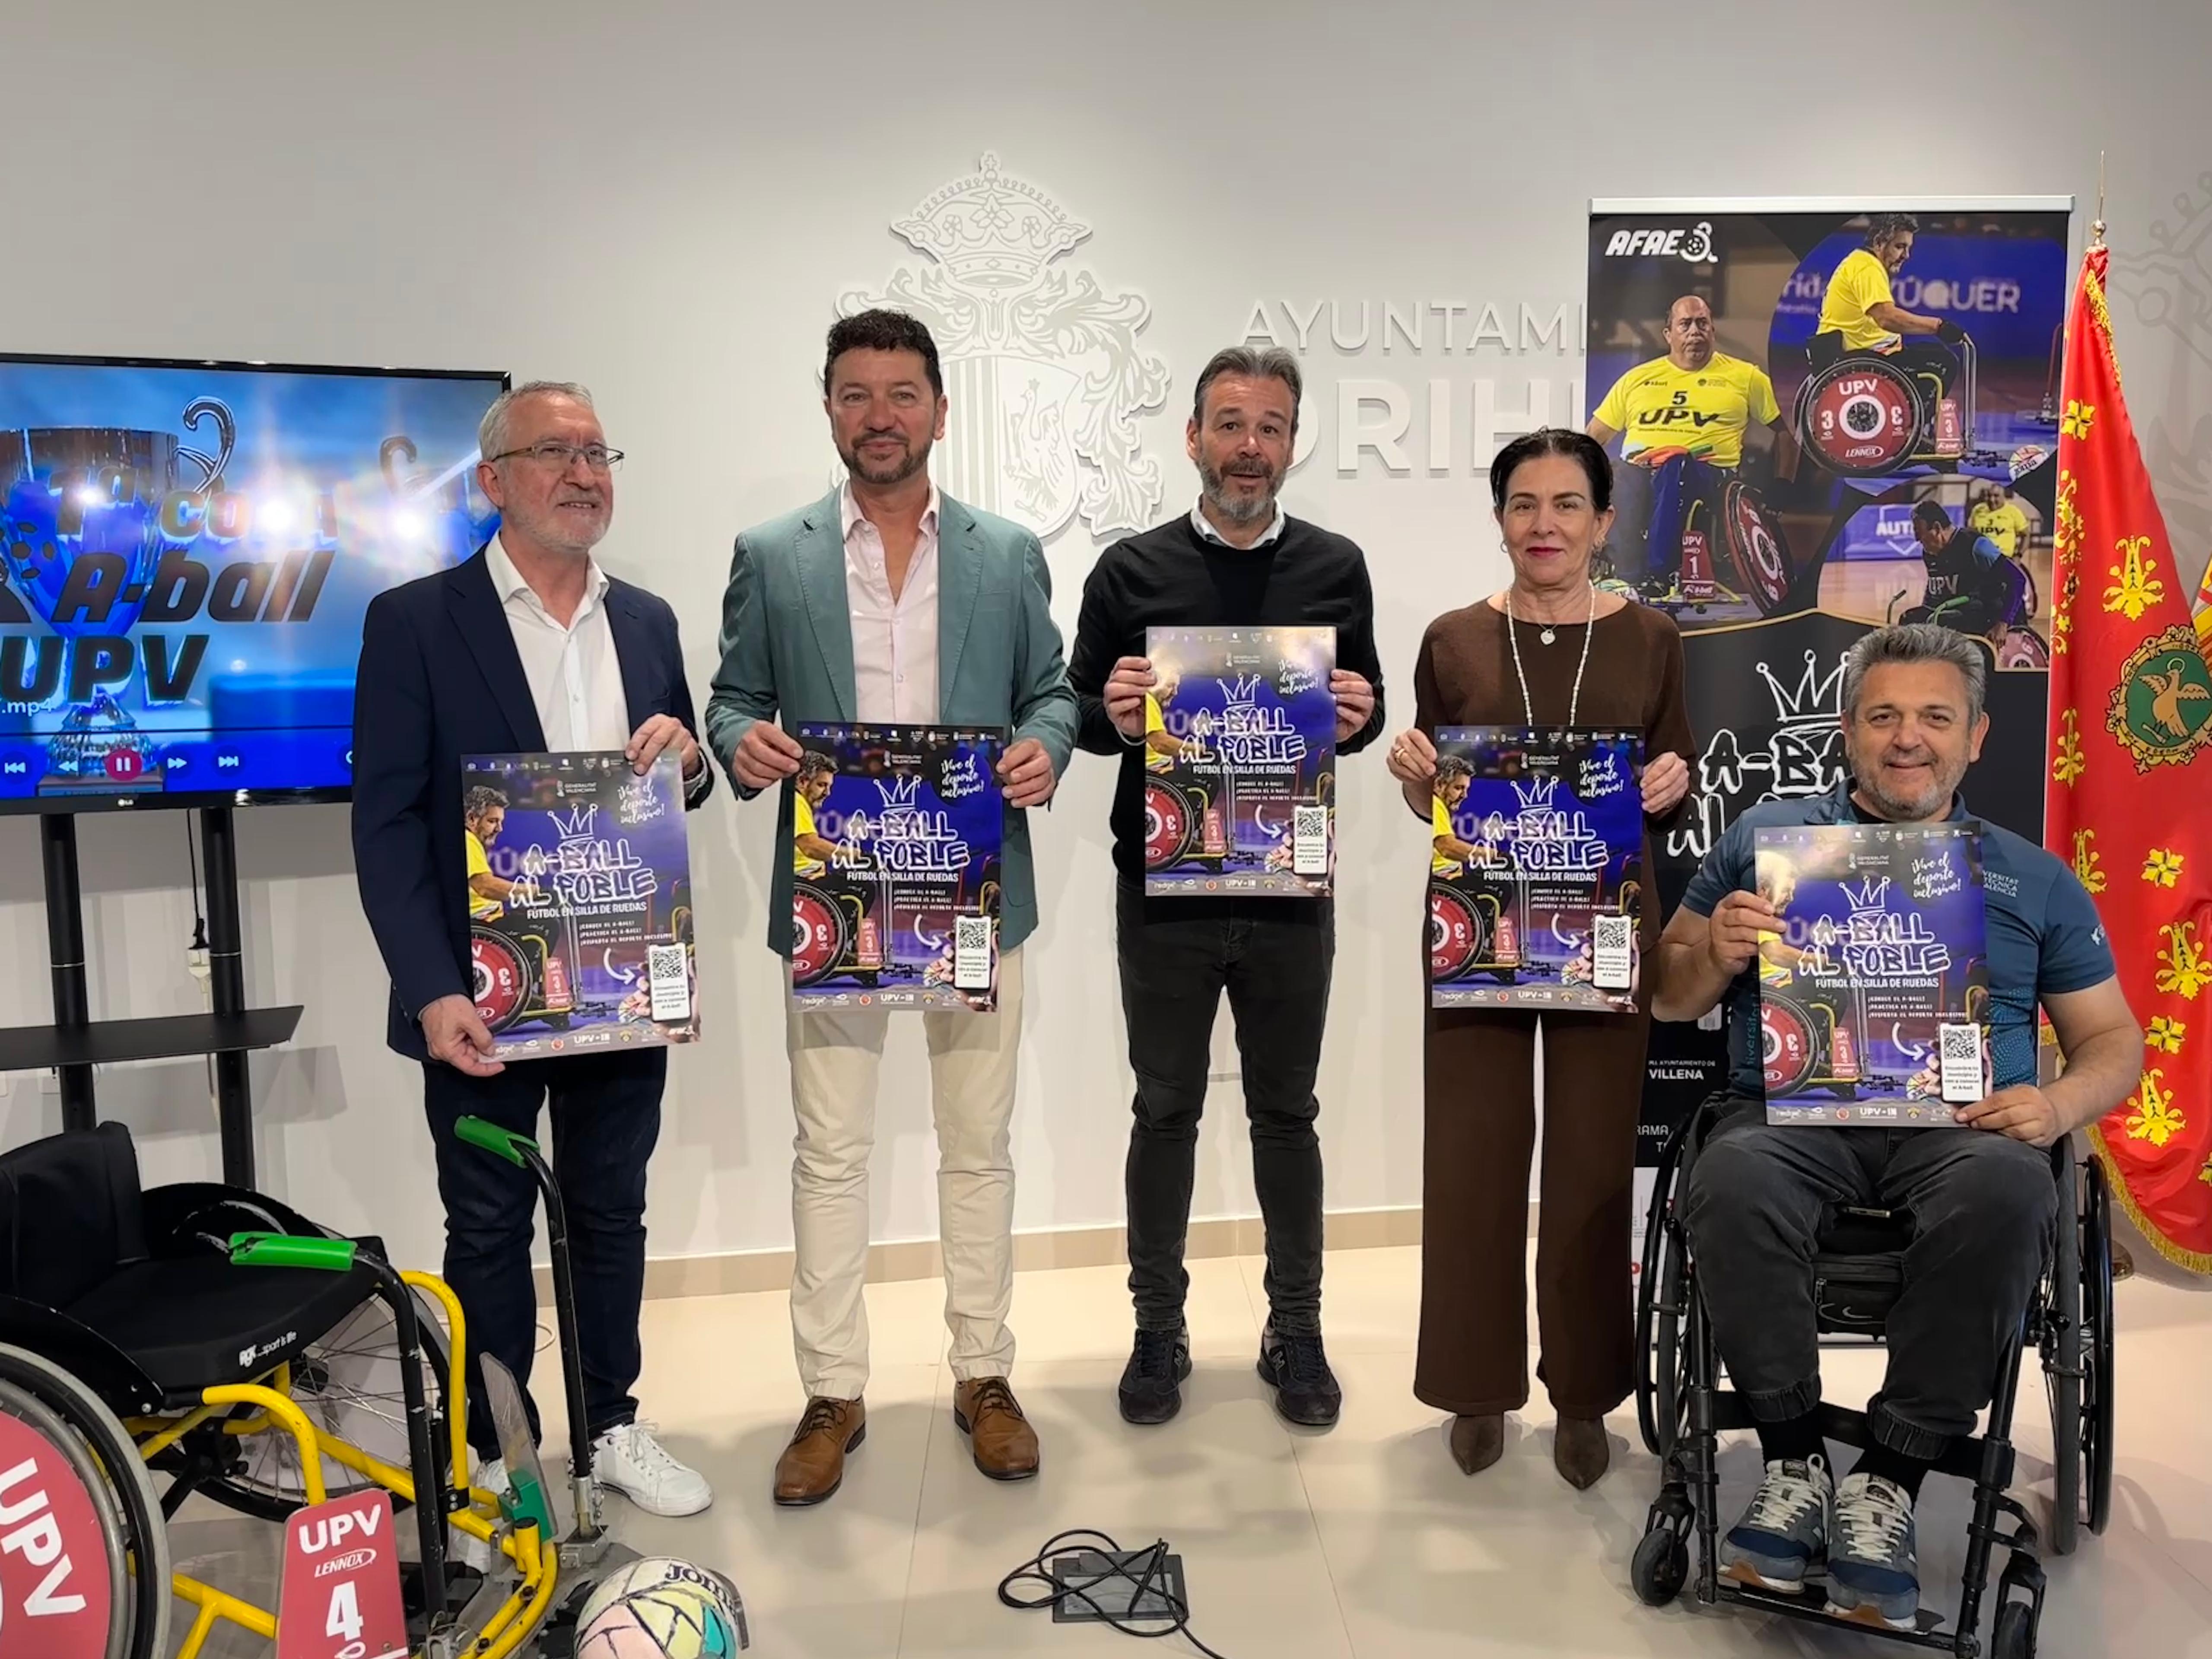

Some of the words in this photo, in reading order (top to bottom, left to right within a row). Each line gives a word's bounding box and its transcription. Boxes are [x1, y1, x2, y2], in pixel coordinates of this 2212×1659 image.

[1605, 229, 1686, 256] AFAE
[1672, 391, 1688, 405] 5
[1839, 378, 1878, 395] UPV
[1288, 380, 1585, 471] RIH
[1639, 409, 1720, 427] UPV
[1821, 410, 1834, 429] 3
[1689, 556, 1698, 574] 1
[51, 550, 337, 623] A-ball
[1, 634, 210, 703] UPV
[1194, 707, 1295, 736] A-BALL
[1179, 734, 1216, 763] AL
[1217, 735, 1307, 763] POBLE
[847, 809, 958, 841] A-BALL
[1484, 810, 1596, 841] A-BALL
[524, 839, 642, 875] A-BALL
[832, 838, 871, 869] AL
[873, 839, 971, 871] POBLE
[1468, 839, 1509, 869] AL
[1510, 840, 1609, 870] POBLE
[509, 875, 553, 908] AL
[553, 868, 658, 904] POBLE
[892, 872, 913, 882] SILLA
[915, 872, 925, 882] DE
[927, 872, 959, 883] RUEDAS
[1528, 871, 1551, 881] SILLA
[1552, 872, 1562, 882] DE
[1564, 872, 1597, 882] RUEDAS
[575, 905, 599, 916] SILLA
[600, 903, 612, 914] DE
[613, 901, 648, 913] RUEDAS
[1814, 912, 1935, 945] A-BALL
[1798, 944, 1841, 976] AL
[1842, 943, 1951, 976] POBLE
[1864, 977, 1889, 988] SILLA
[1890, 977, 1901, 988] DE
[1903, 977, 1939, 988] RUEDAS
[1649, 1069, 1704, 1080] VILLENA
[0, 1458, 86, 1617] UPV
[299, 1504, 381, 1554] UPV
[315, 1550, 367, 1578] LENNOX
[325, 1581, 363, 1641] 4
